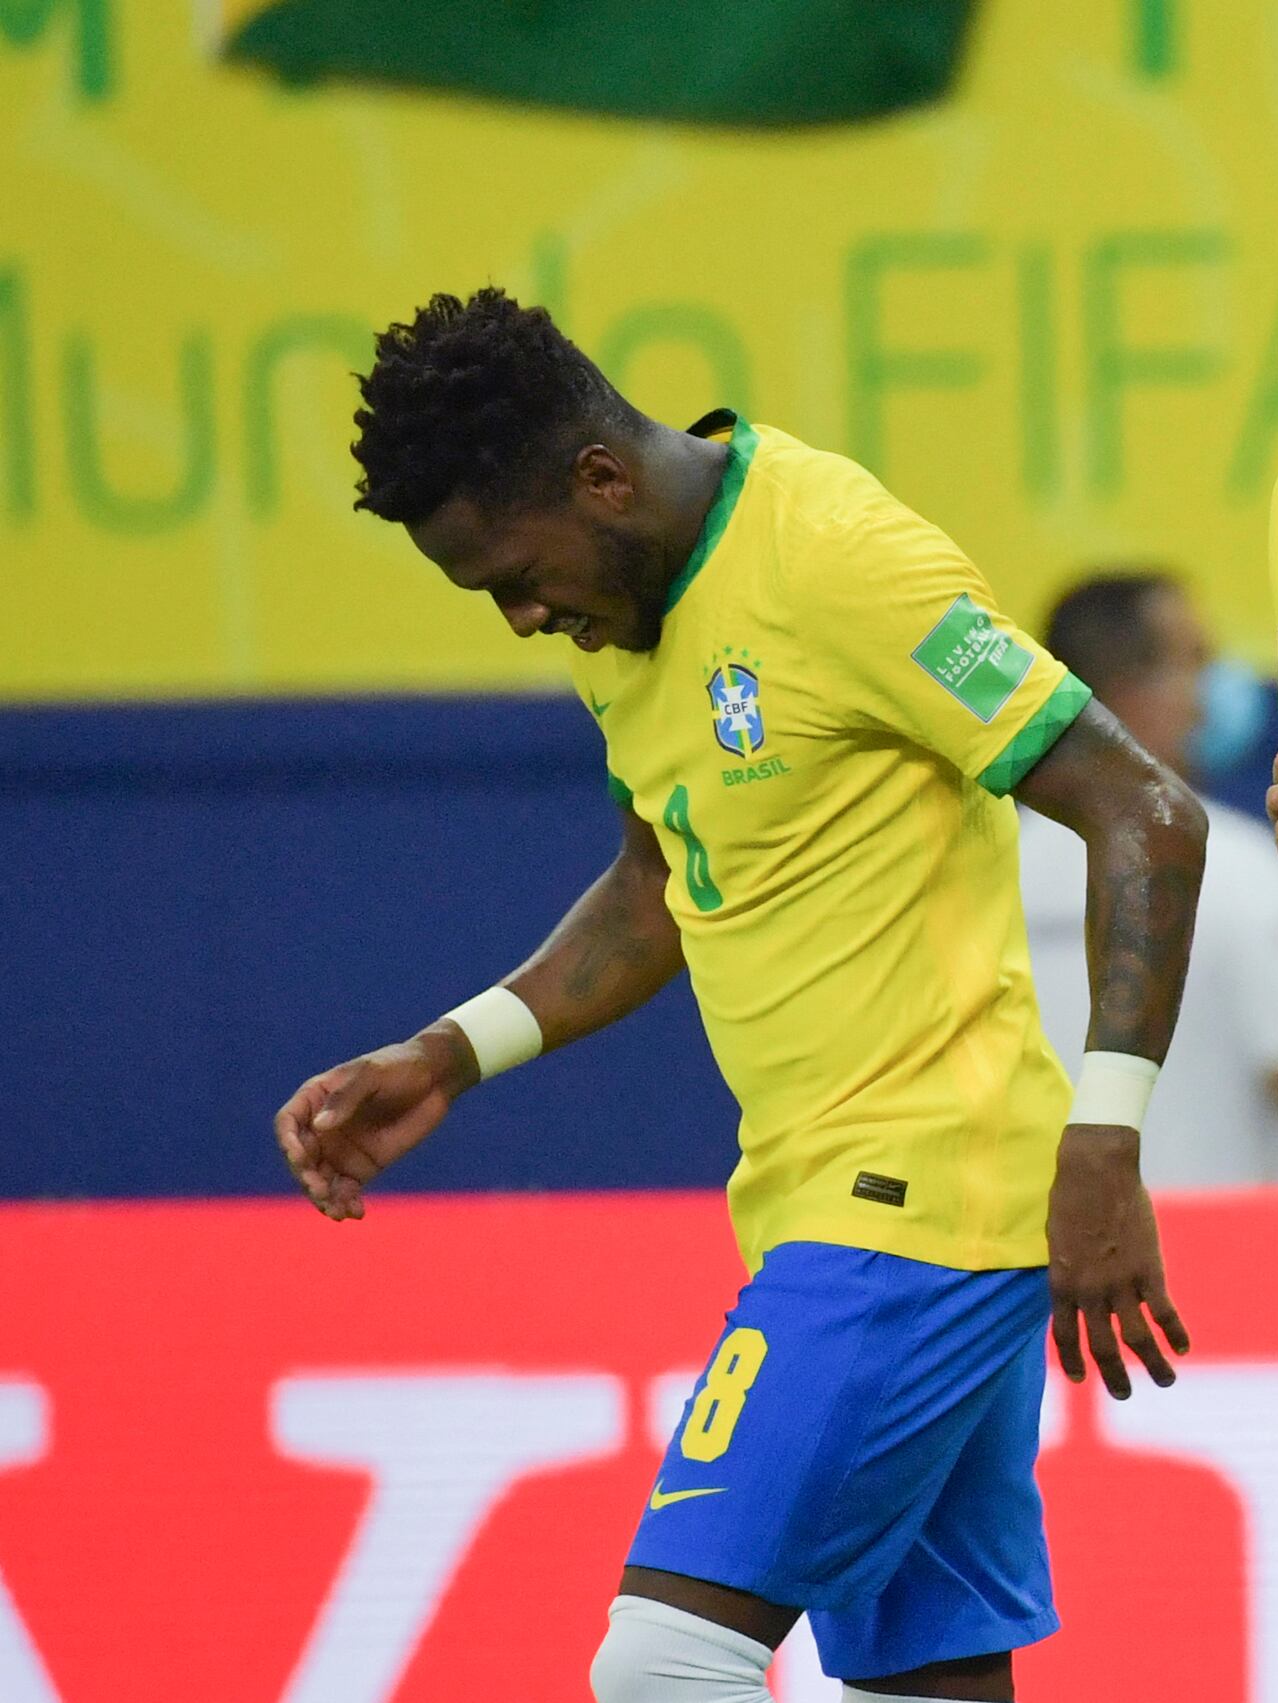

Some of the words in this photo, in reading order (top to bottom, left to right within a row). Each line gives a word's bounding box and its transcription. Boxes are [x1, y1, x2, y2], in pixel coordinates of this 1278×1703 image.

[936, 616, 985, 675] LIVING
[987, 637, 1009, 667] FIFA
[723, 700, 749, 716] CBF
[721, 757, 791, 787] BRASIL
[680, 1327, 768, 1463] 8
